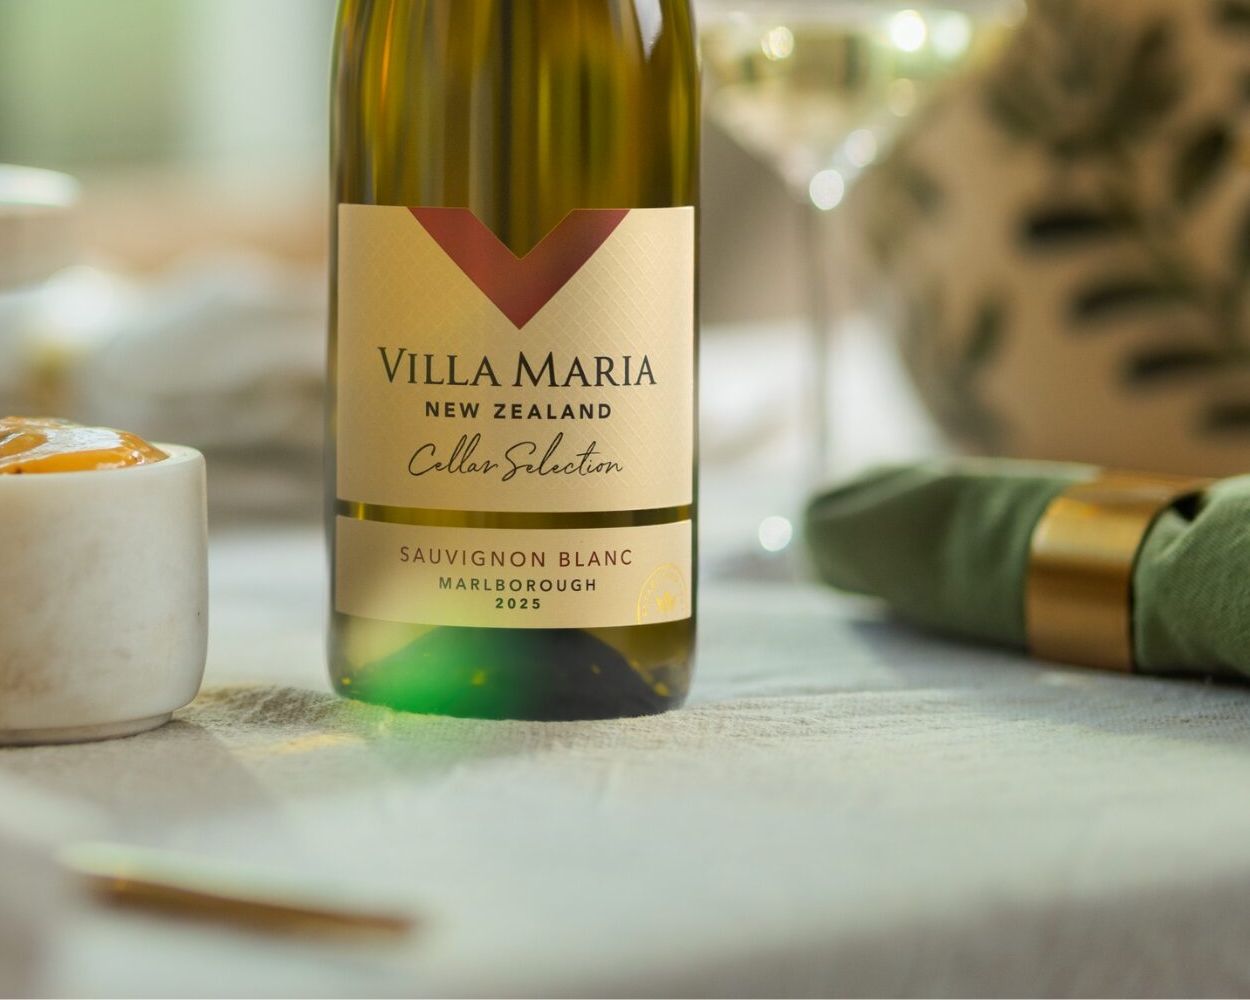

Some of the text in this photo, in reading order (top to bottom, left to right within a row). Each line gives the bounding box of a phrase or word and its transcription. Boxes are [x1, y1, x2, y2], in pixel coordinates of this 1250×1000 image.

[377, 347, 657, 387] VILLA MARIA
[425, 401, 613, 420] NEW ZEALAND
[408, 432, 624, 482] Cellar Selection
[400, 546, 633, 567] SAUVIGNON BLANC
[438, 576, 597, 592] MARLBOROUGH
[495, 597, 542, 610] 2025
